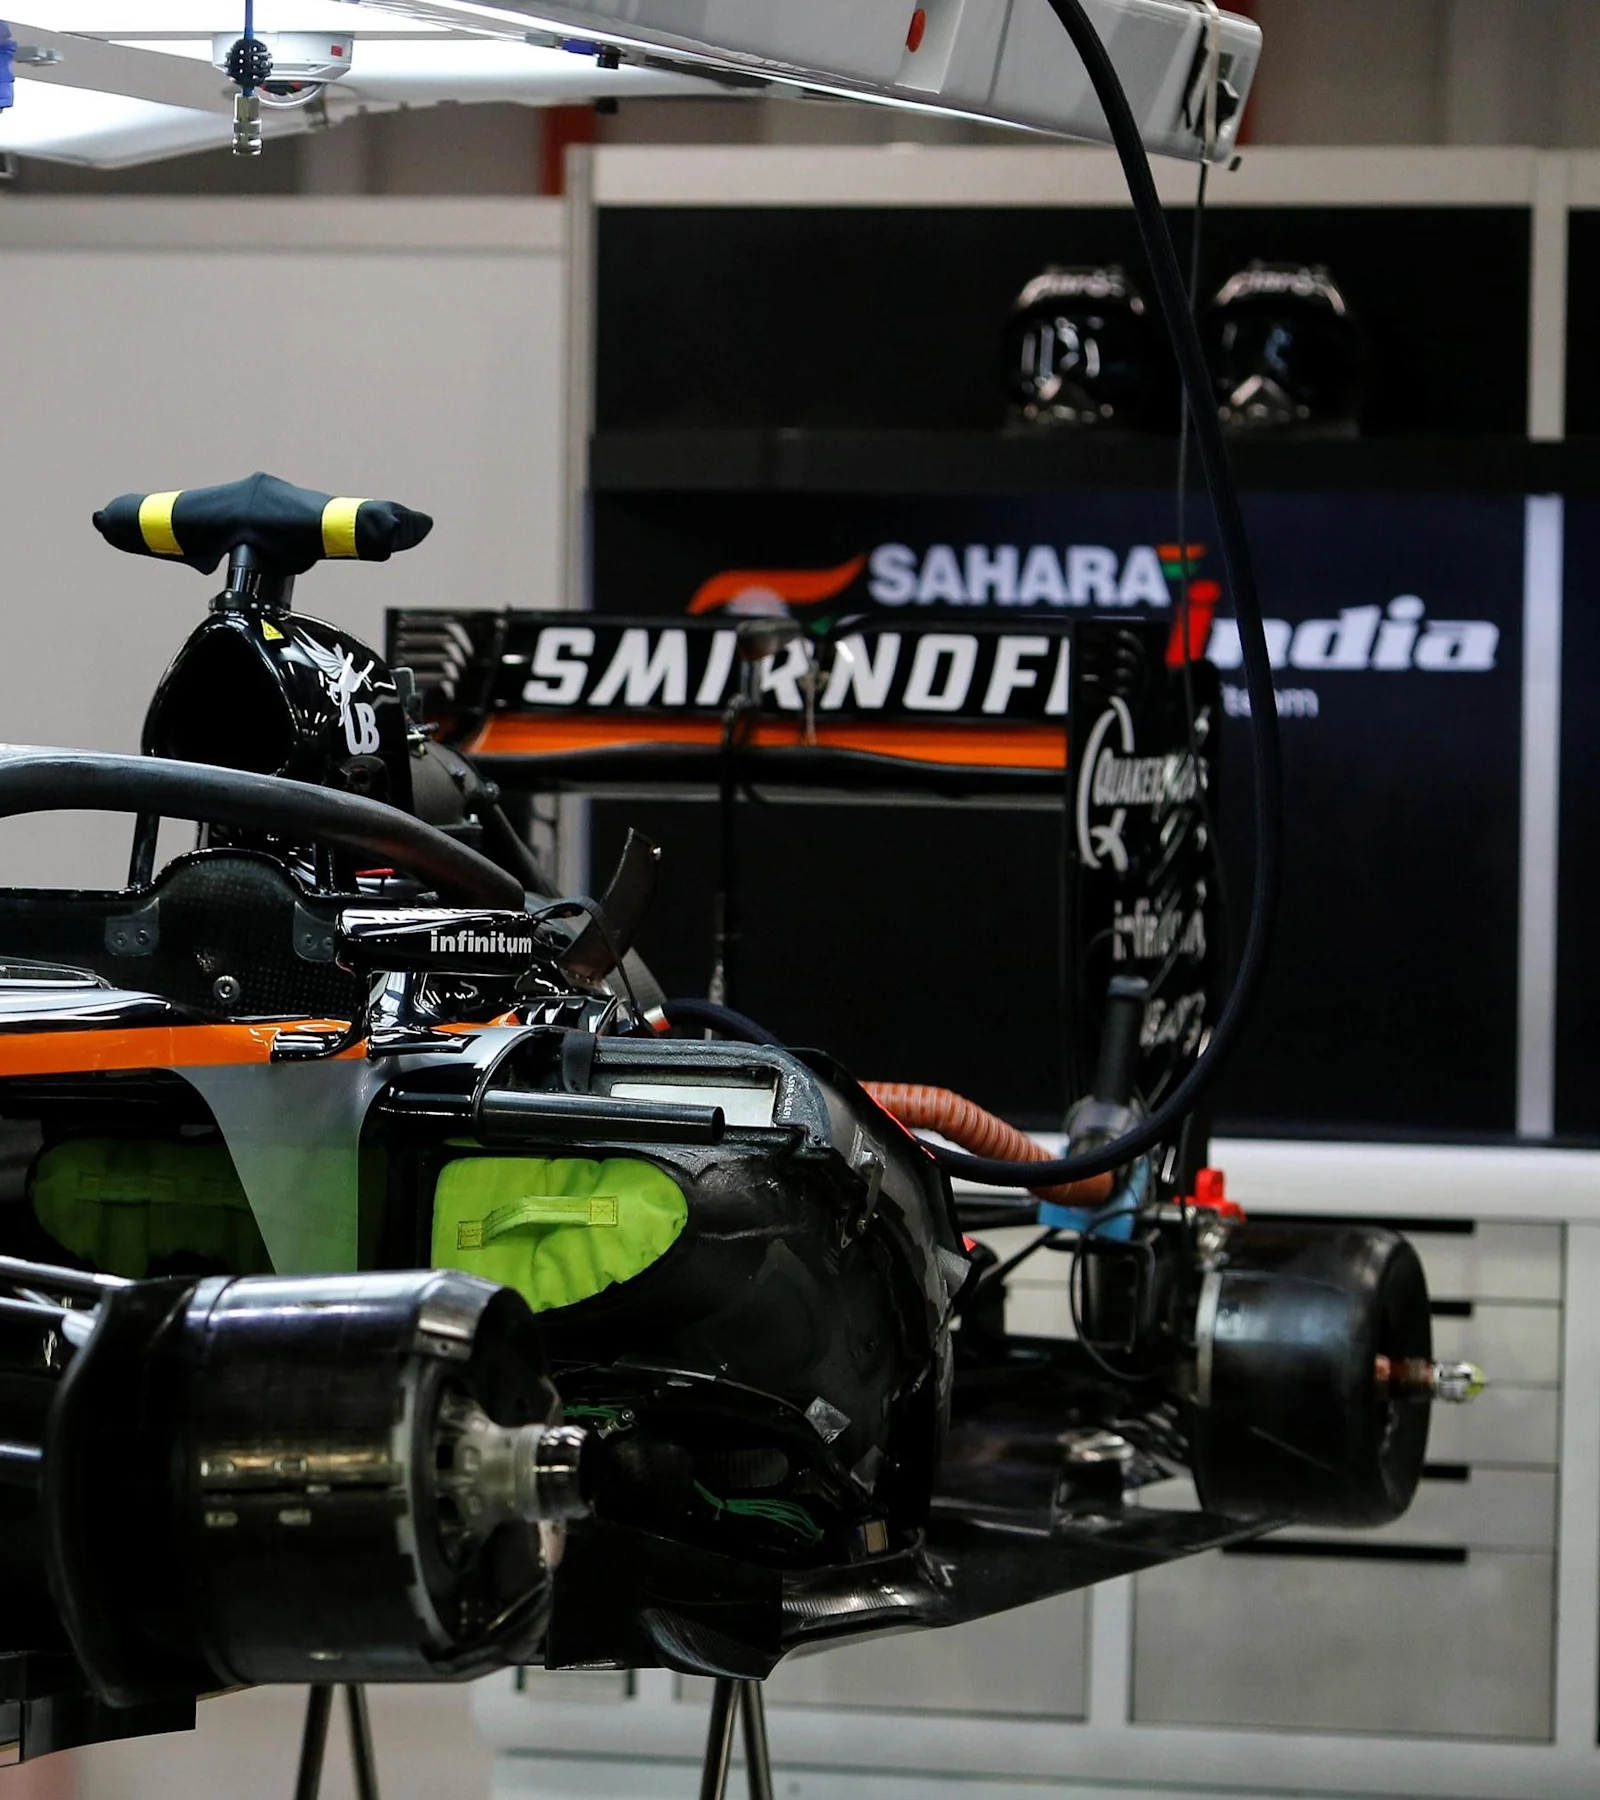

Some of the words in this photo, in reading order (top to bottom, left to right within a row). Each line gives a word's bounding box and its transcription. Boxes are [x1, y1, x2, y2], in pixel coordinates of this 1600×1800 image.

[871, 543, 1171, 608] SAHARA
[521, 627, 1069, 715] SMIRNOF
[430, 929, 532, 954] infinitum
